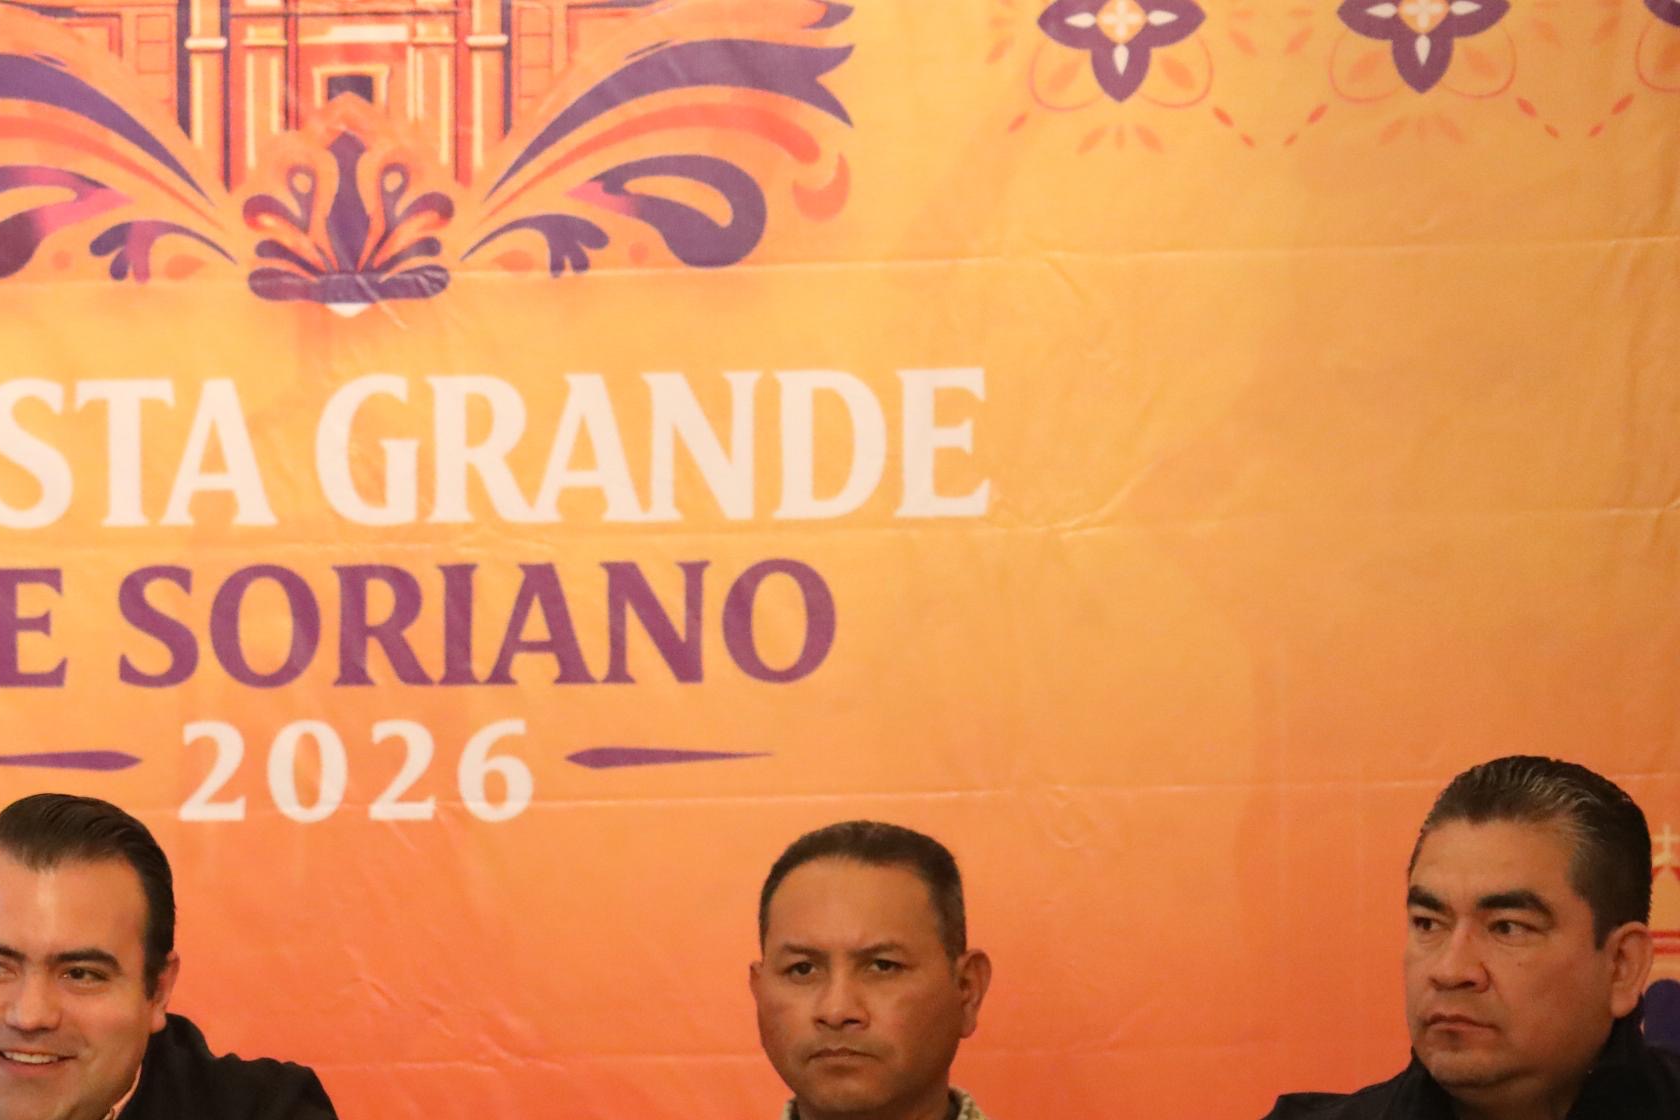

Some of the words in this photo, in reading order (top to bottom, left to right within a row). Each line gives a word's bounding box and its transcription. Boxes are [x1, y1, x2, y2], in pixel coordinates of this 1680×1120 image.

[315, 368, 992, 526] GRANDE
[118, 557, 837, 689] SORIANO
[178, 718, 535, 822] 2026
